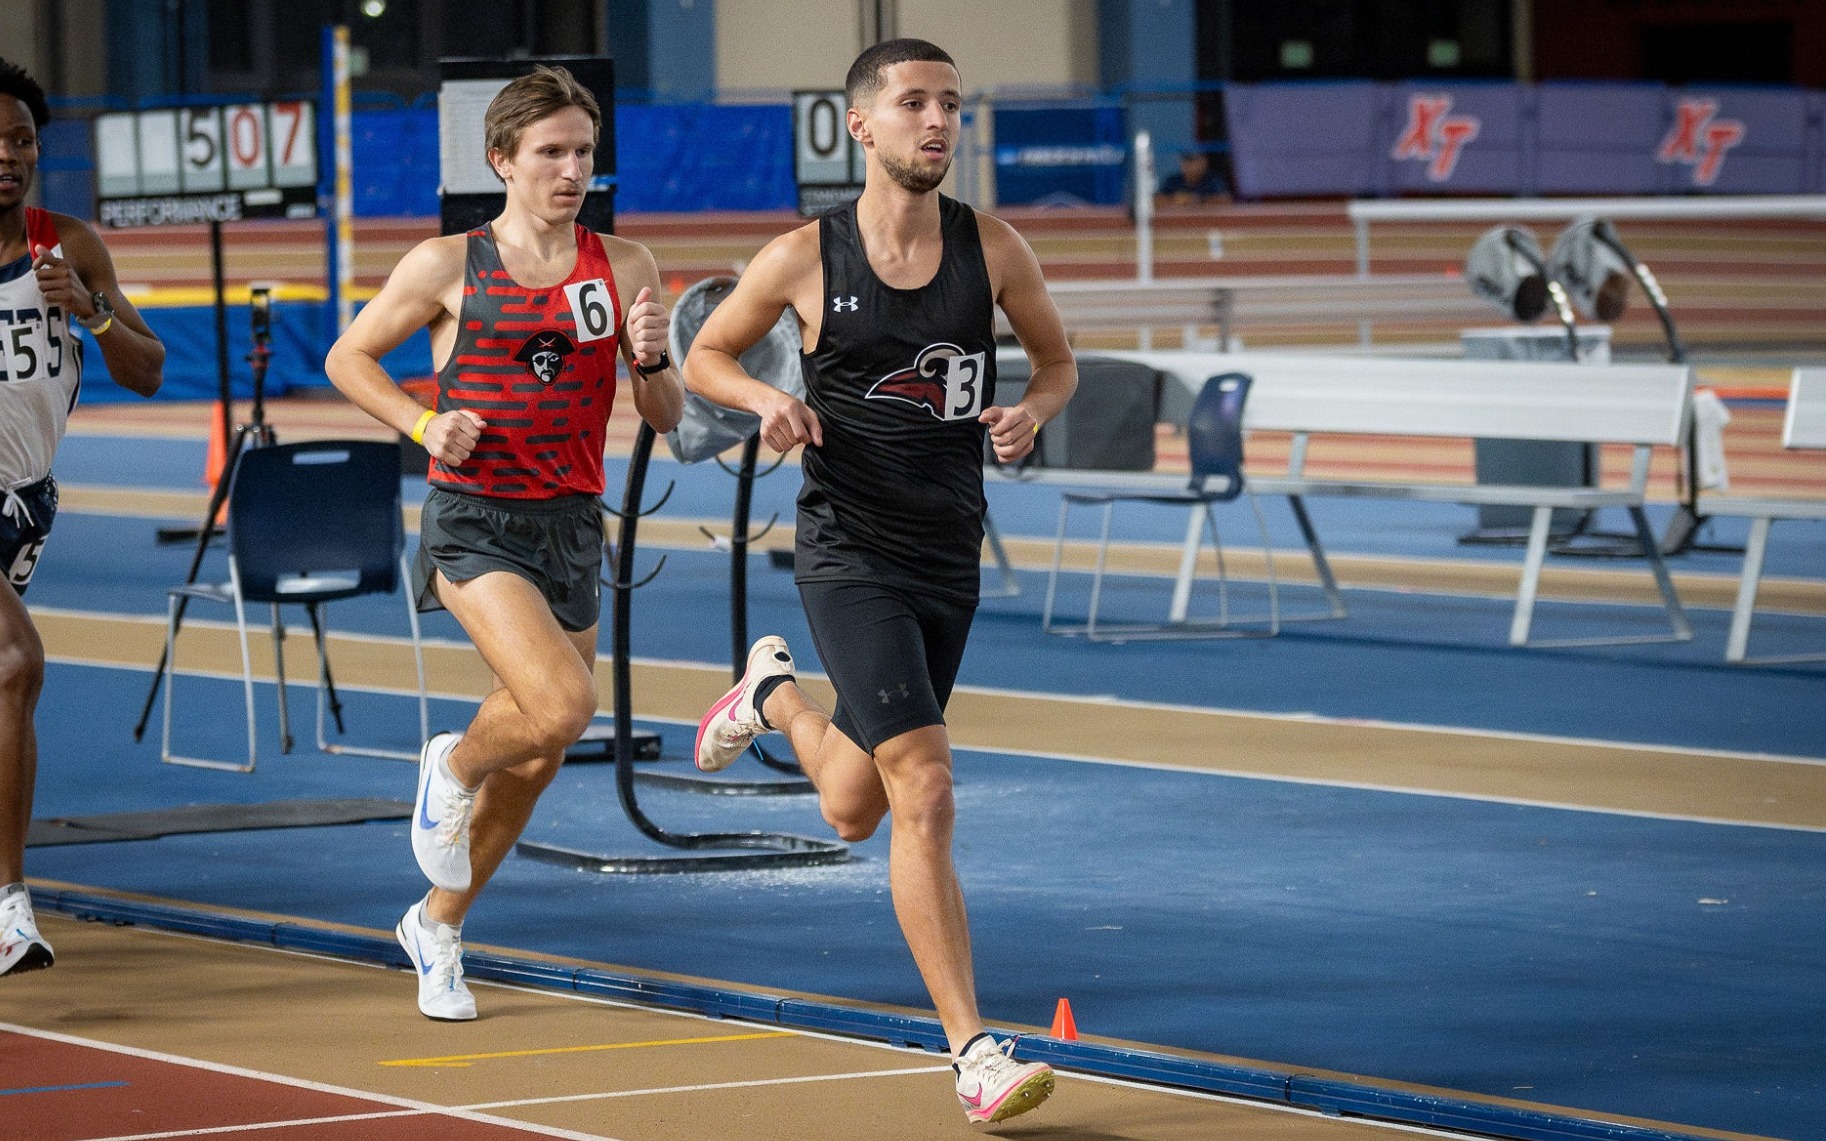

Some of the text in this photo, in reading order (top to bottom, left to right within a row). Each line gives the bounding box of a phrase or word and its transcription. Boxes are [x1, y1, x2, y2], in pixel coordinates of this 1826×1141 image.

[1393, 93, 1480, 182] XT
[1658, 98, 1745, 185] XT
[99, 194, 243, 228] PERFORMANCE
[579, 283, 608, 337] 6
[11, 327, 37, 379] 5
[953, 358, 978, 416] 3
[13, 539, 46, 582] 5
